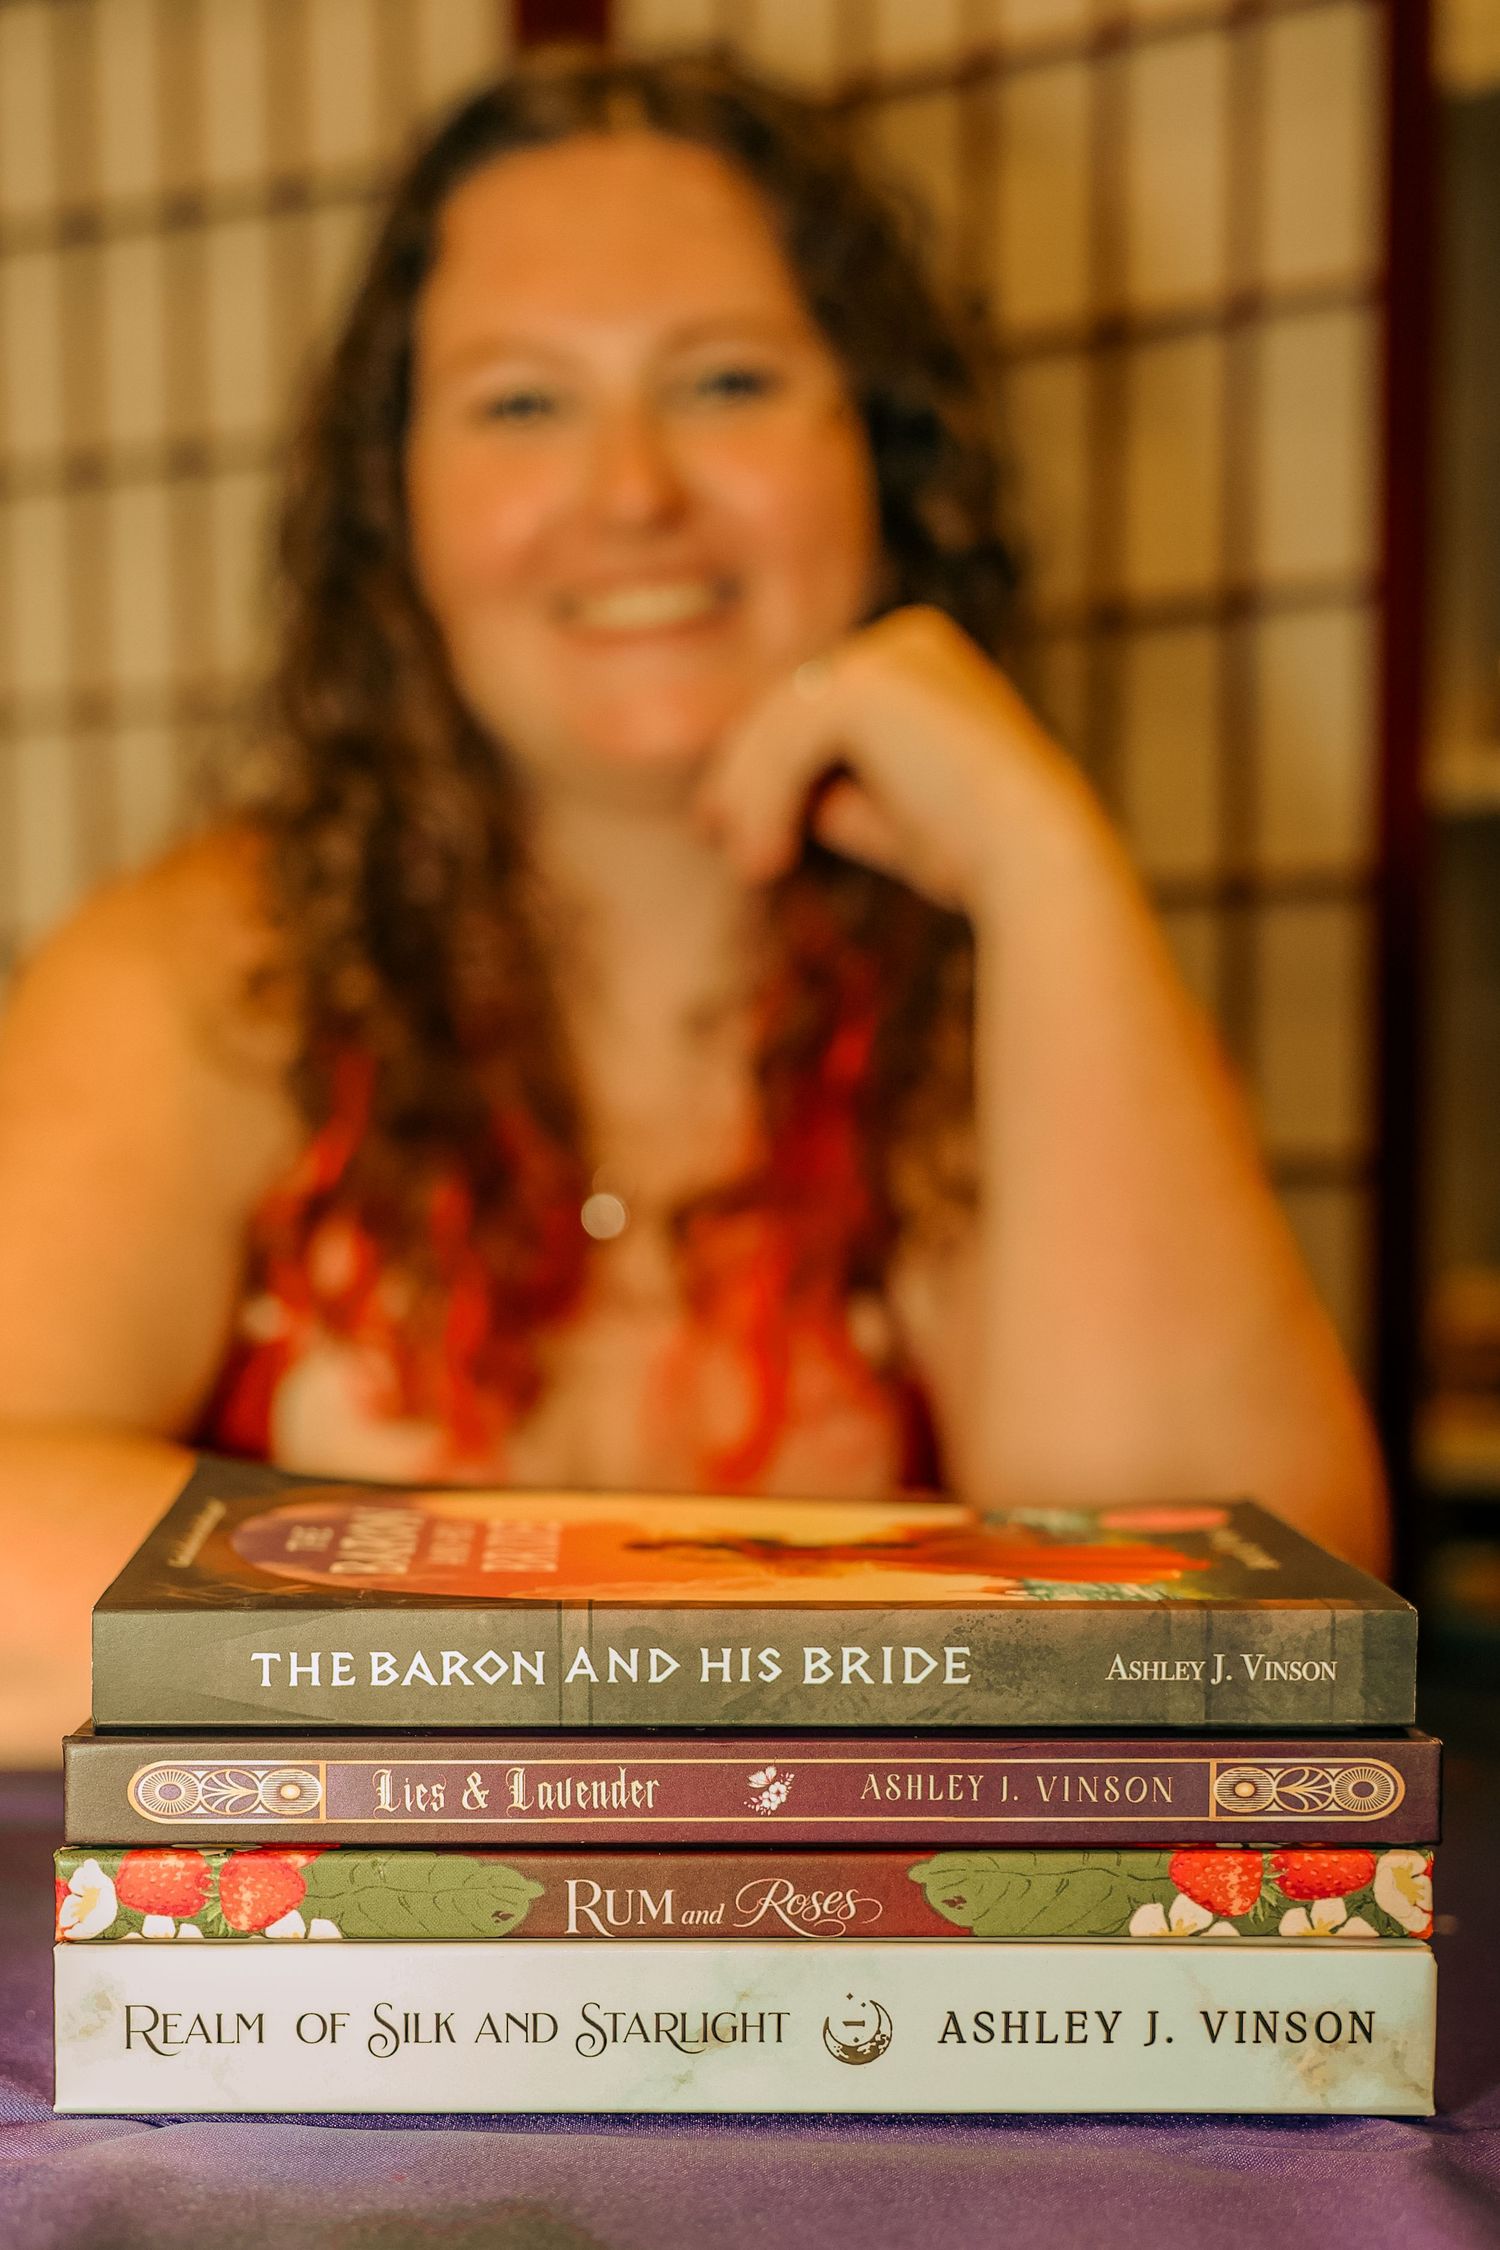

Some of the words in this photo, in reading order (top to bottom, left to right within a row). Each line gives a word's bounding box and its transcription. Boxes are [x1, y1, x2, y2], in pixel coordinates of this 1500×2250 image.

[250, 1651, 356, 1687] THE
[369, 1649, 546, 1687] BARON
[564, 1646, 681, 1684] AND
[699, 1647, 783, 1683] HIS
[802, 1645, 972, 1685] BRIDE
[1104, 1652, 1207, 1682] ASHLEY
[1210, 1653, 1233, 1686] J.
[1239, 1653, 1338, 1682] VINSON
[371, 1768, 447, 1813] Lies
[460, 1771, 490, 1811] &
[505, 1765, 661, 1814] Lavender
[859, 1772, 985, 1803] ASHLEY
[999, 1774, 1020, 1803] J.
[1036, 1774, 1174, 1804] VINSON
[564, 1878, 676, 1937] RUM
[681, 1902, 726, 1926] and
[732, 1877, 883, 1938] Roses
[123, 2003, 265, 2057] REALM
[295, 2012, 351, 2045] OF
[366, 2001, 457, 2059] SILK
[474, 2012, 559, 2045] AND
[574, 2001, 791, 2059] STARLIGHT
[937, 2010, 1123, 2045] ASHLEY
[1143, 2010, 1175, 2047] J.
[1199, 2010, 1376, 2045] VINSON
